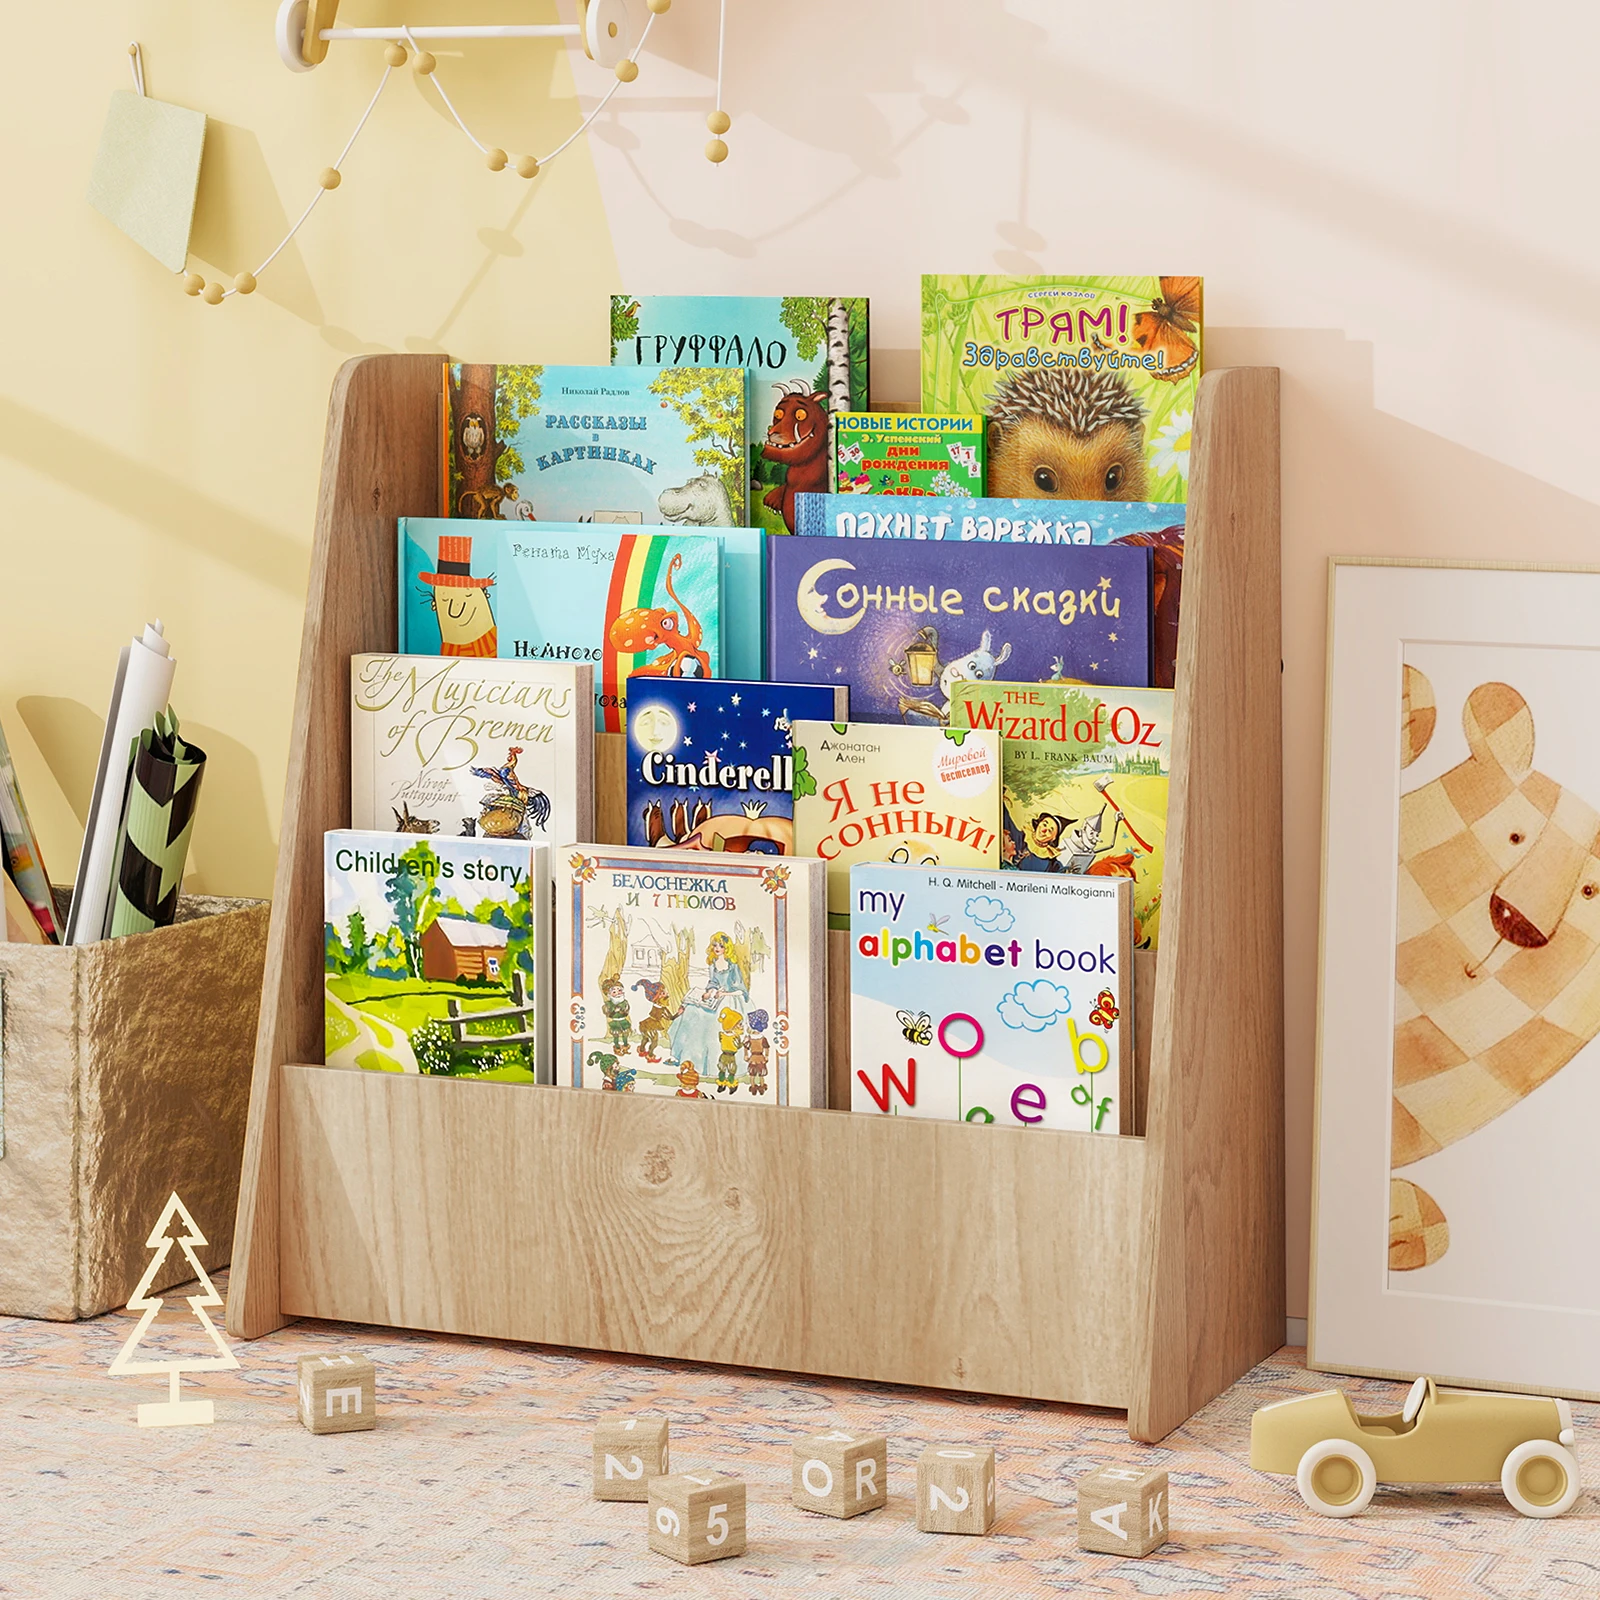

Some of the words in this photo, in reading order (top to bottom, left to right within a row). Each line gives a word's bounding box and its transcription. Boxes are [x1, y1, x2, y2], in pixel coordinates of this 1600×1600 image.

[996, 304, 1128, 344] ТРЯМ!
[635, 334, 788, 369] ГРУФФАЛО
[963, 342, 1164, 371] Здравствуйте!
[561, 386, 599, 396] Николай
[601, 387, 630, 397] Радлов
[545, 414, 647, 430] РАССКАЗЫ
[837, 416, 892, 430] НОВЫЕ
[897, 417, 973, 431] ИСТОРИИ
[876, 433, 942, 444] Успенский
[536, 445, 658, 476] КАРТИНКАХ
[982, 583, 1120, 625] сказки
[355, 660, 571, 717] Musicians
[359, 657, 405, 698] The
[1003, 691, 1045, 706] THE
[380, 710, 427, 757] of
[415, 705, 553, 770] Bremen
[963, 700, 1068, 742] Wizard
[1073, 703, 1107, 743] of
[1111, 706, 1163, 748] Oz
[820, 739, 881, 753] Джонатан
[835, 753, 866, 764] Ален
[1014, 751, 1028, 760] BY
[1031, 751, 1041, 761] L.
[1044, 752, 1079, 762] FRANK
[1083, 754, 1113, 764] BAUM
[823, 777, 859, 823] Я
[869, 780, 925, 807] не
[336, 849, 455, 879] Children's
[463, 860, 523, 888] story
[612, 873, 728, 893] БЕЛОСНЕЖКА
[625, 893, 640, 907] И
[652, 893, 661, 908] 7
[667, 894, 736, 911] ГНОМОВ
[928, 877, 940, 887] H.
[942, 877, 954, 889] Q.
[957, 878, 997, 890] Mitchell
[1006, 882, 1048, 894] Marileni
[1051, 884, 1115, 898] Malkogianni
[859, 889, 905, 921] my
[858, 928, 1022, 967] alphabet
[1035, 938, 1116, 975] book
[1067, 1017, 1109, 1074] b
[1010, 1082, 1047, 1123] e
[326, 1386, 362, 1417] E
[605, 1453, 644, 1481] 2
[855, 1458, 879, 1501] R
[930, 1483, 970, 1512] 2
[705, 1503, 729, 1546] 5
[1090, 1501, 1128, 1541] A
[1149, 1491, 1164, 1538] K
